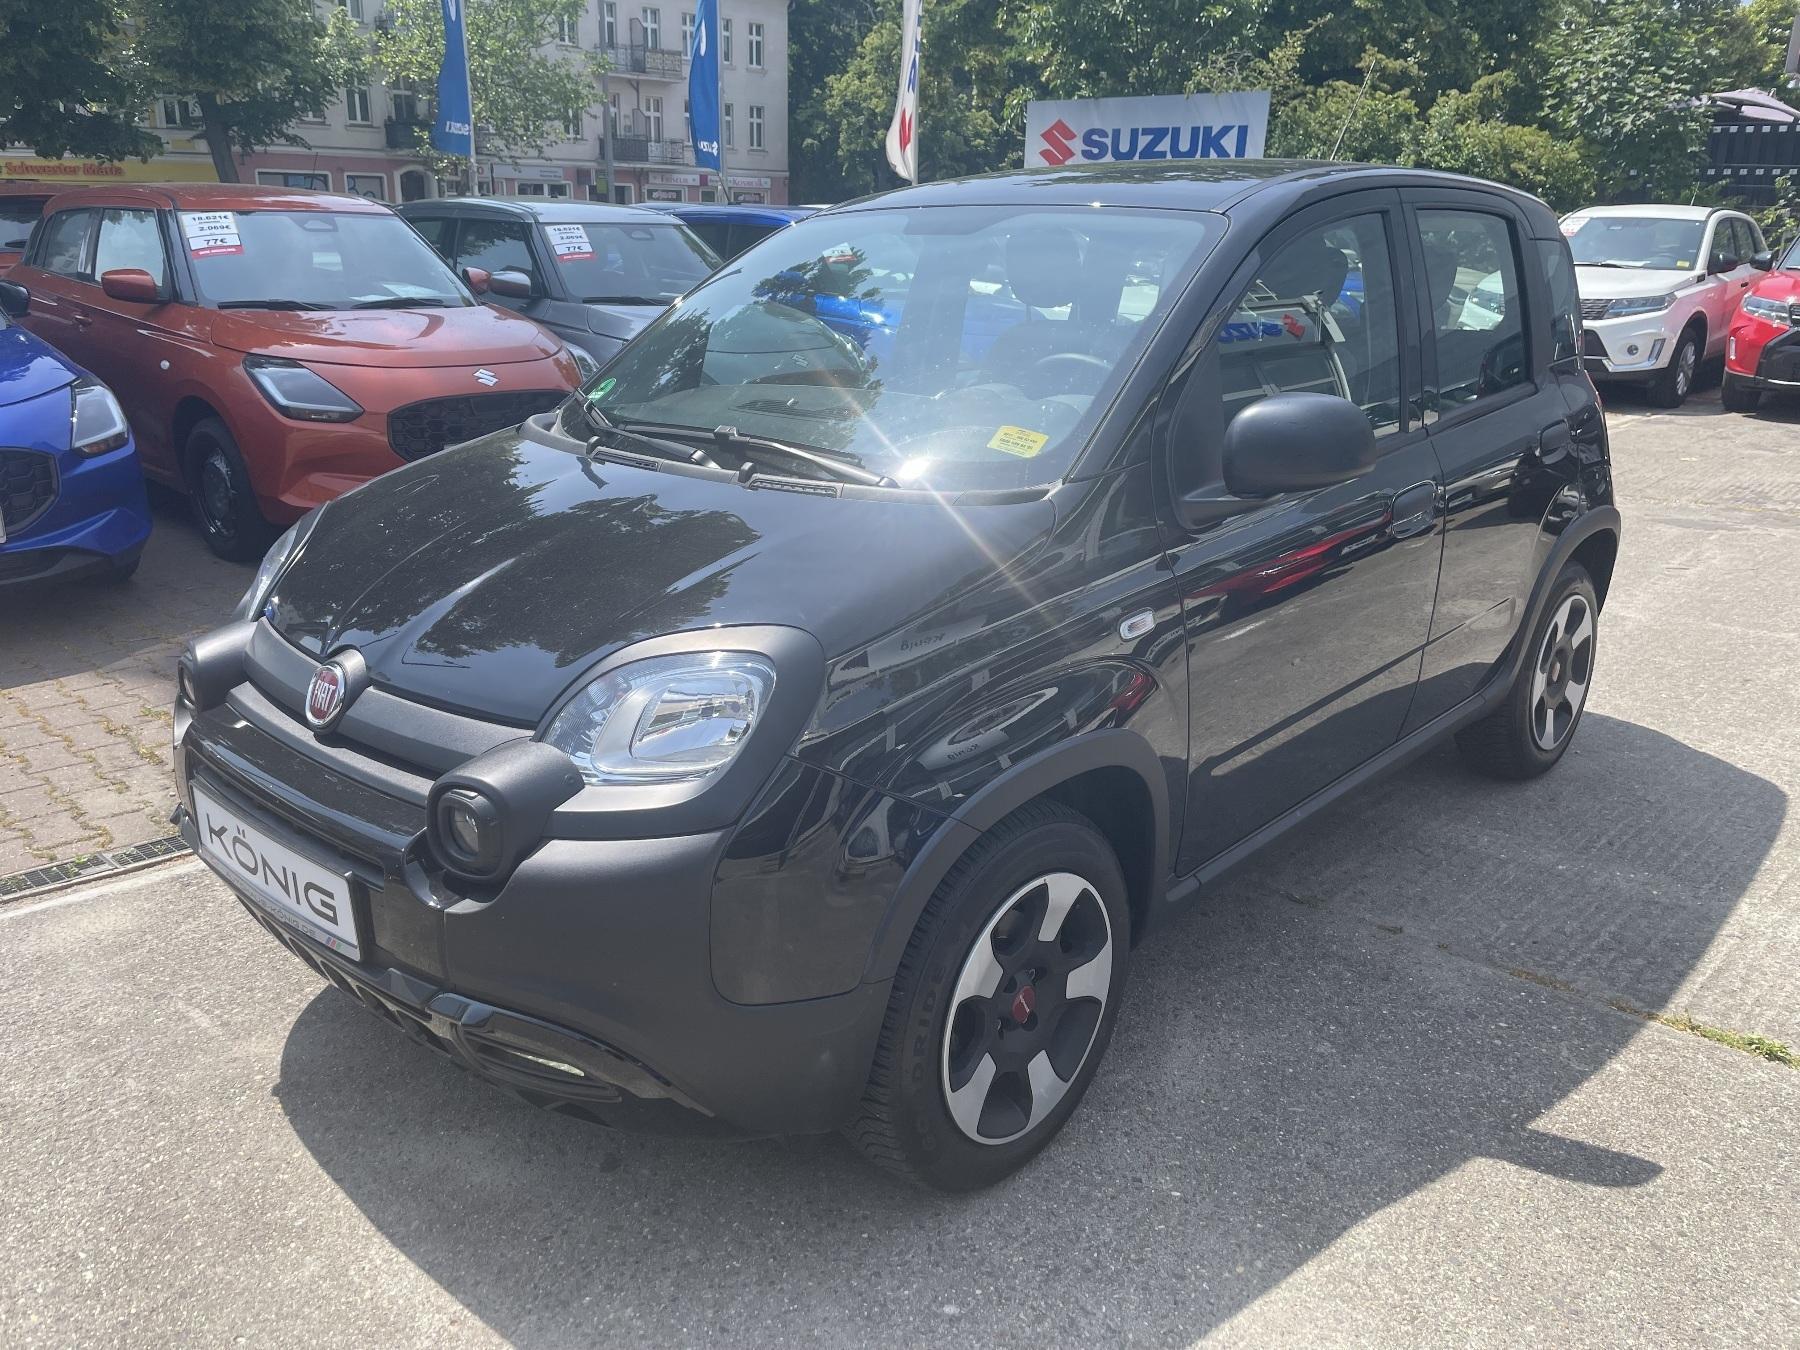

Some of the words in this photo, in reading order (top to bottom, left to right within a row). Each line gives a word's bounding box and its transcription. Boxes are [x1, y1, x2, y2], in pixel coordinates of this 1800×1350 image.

[1080, 124, 1249, 161] SUZUKI
[203, 237, 228, 246] 77€
[311, 679, 337, 712] FIAT
[205, 812, 339, 927] KÖNIG
